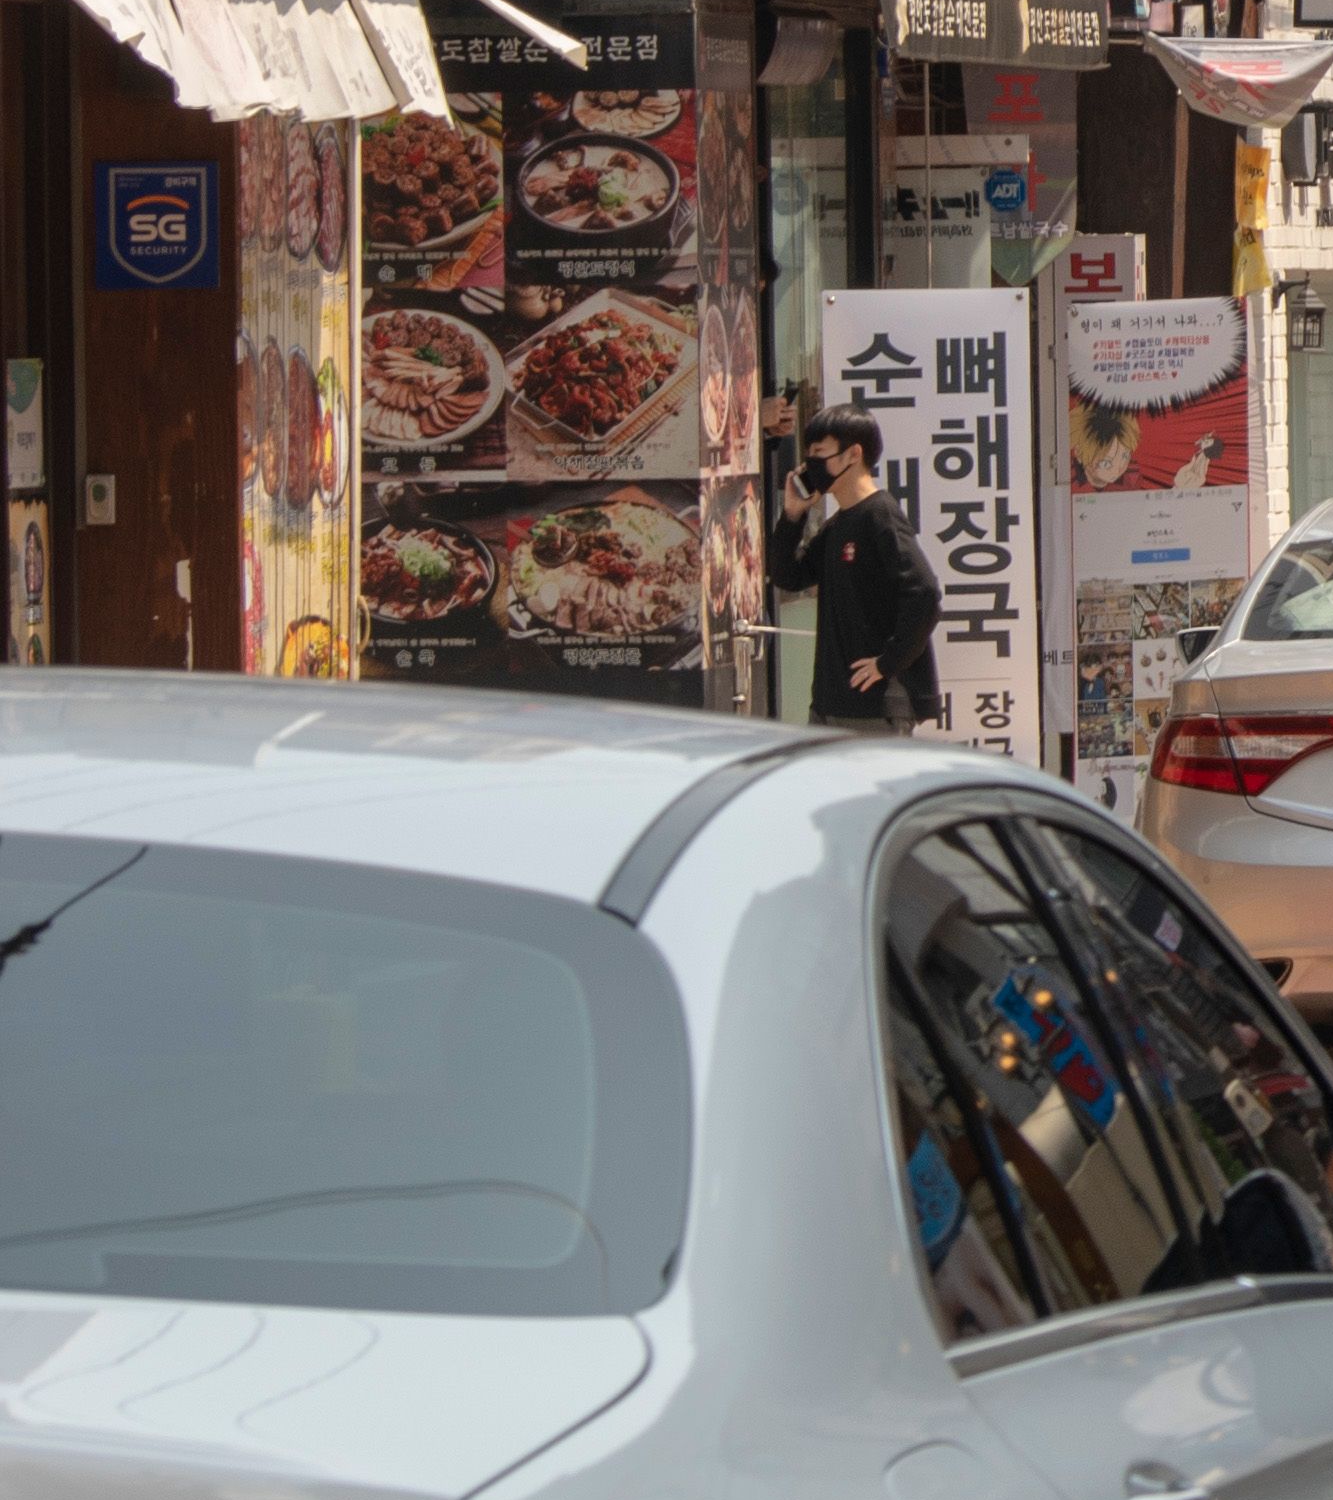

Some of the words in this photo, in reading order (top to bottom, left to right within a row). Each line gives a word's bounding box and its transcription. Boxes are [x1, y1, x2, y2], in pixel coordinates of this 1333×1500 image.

[991, 181, 1021, 199] ADT
[127, 211, 188, 244] SG
[128, 243, 189, 257] SECURITY
[930, 330, 1021, 660] 뼈해장국
